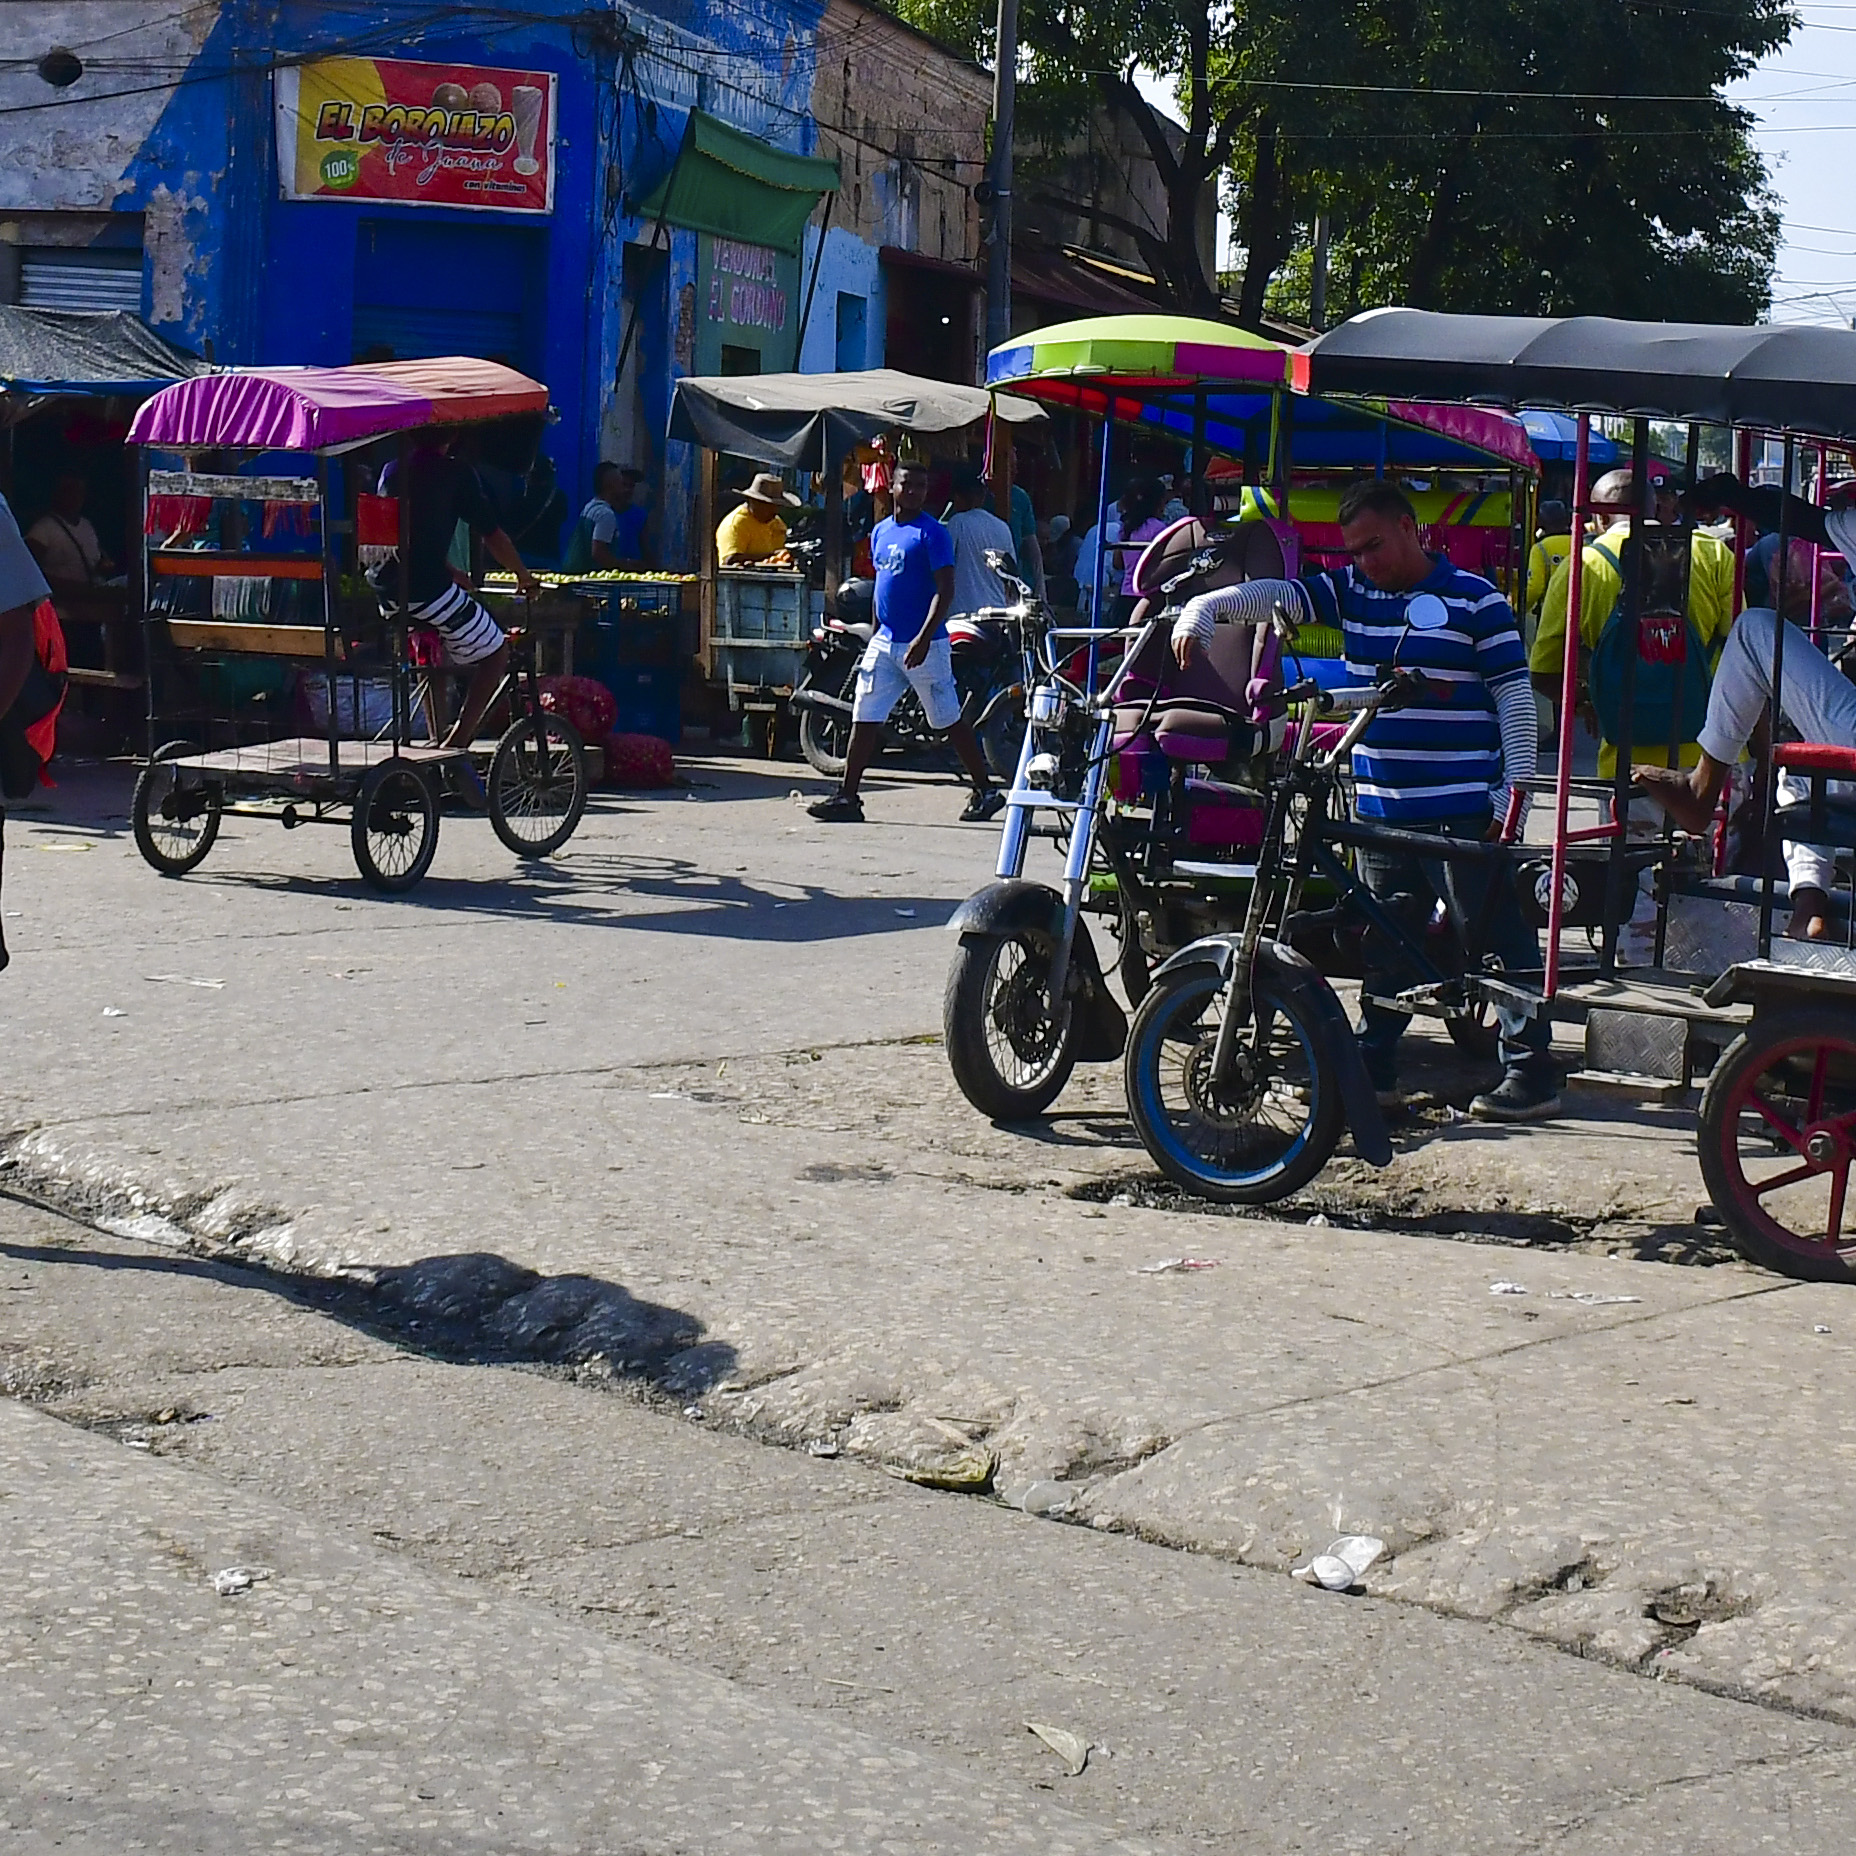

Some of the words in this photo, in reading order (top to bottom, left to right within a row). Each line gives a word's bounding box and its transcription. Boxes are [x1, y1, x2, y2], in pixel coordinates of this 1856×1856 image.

[315, 102, 356, 142] EL
[386, 138, 413, 176] de
[464, 180, 481, 190] con
[483, 181, 527, 193] vitaminas
[709, 275, 725, 322] EL
